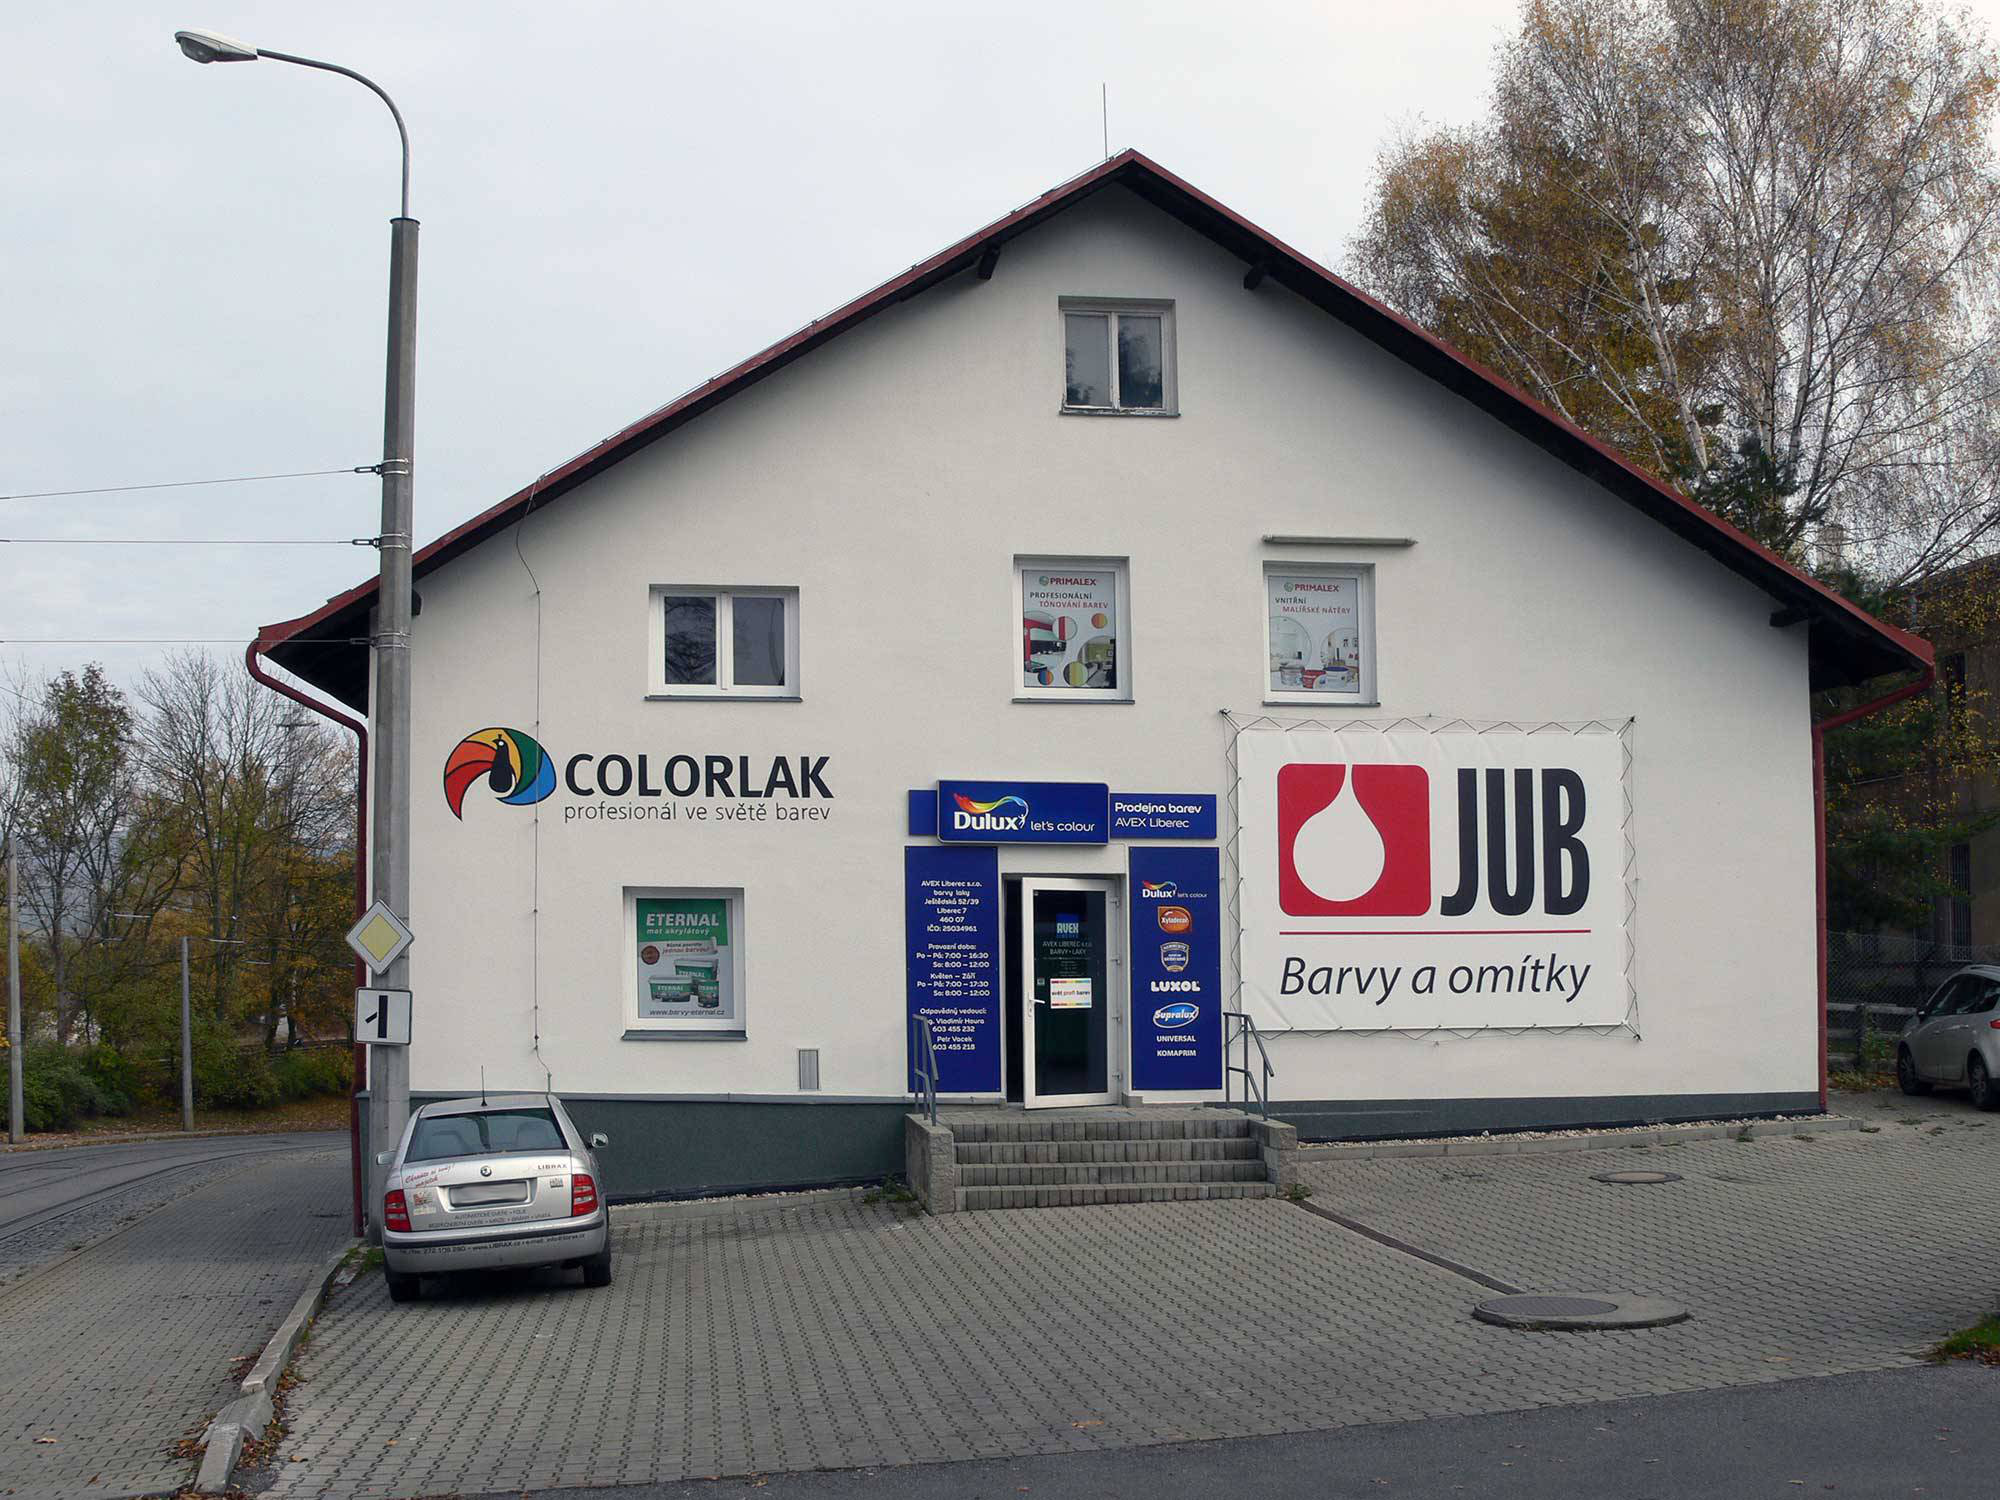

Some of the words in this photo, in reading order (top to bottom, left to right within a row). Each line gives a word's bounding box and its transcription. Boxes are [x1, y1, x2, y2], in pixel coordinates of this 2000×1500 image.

[1050, 577, 1097, 586] PRIMALEX
[1294, 583, 1340, 592] PRIMALEX
[1029, 591, 1092, 600] PROFESIONÁLNÍ
[1275, 596, 1307, 604] VNITŘNÍ
[1039, 599, 1081, 608] TÓNOVÁNÍ
[1083, 601, 1108, 609] BAREV
[1282, 605, 1320, 613] MALÍŘSKÉ
[1322, 606, 1351, 614] NÁTĚRY
[565, 753, 834, 799] COLORLAK
[564, 801, 677, 823] profesionál
[685, 806, 707, 820] ve
[715, 802, 767, 820] světě
[776, 802, 831, 820] barev
[1114, 802, 1167, 815] Prodejna
[1168, 803, 1202, 814] barev
[953, 811, 1019, 831] Dulux
[1030, 820, 1055, 832] let's
[1057, 820, 1095, 833] colour
[1115, 818, 1147, 828] AVEX
[1149, 817, 1190, 828] Liberec
[1440, 767, 1591, 917] JUB
[933, 889, 953, 897] barvy
[955, 889, 970, 897] laky
[1142, 888, 1173, 898] Dulux
[646, 913, 720, 926] ETERNAL
[927, 923, 941, 932] IČO:
[1280, 956, 1401, 1006] Barvy
[1411, 966, 1436, 994] a
[1449, 953, 1591, 1003] omítky
[1150, 980, 1201, 992] LUXOL
[1154, 1008, 1197, 1022] Supralux
[1156, 1049, 1197, 1057] KOMAPRIM
